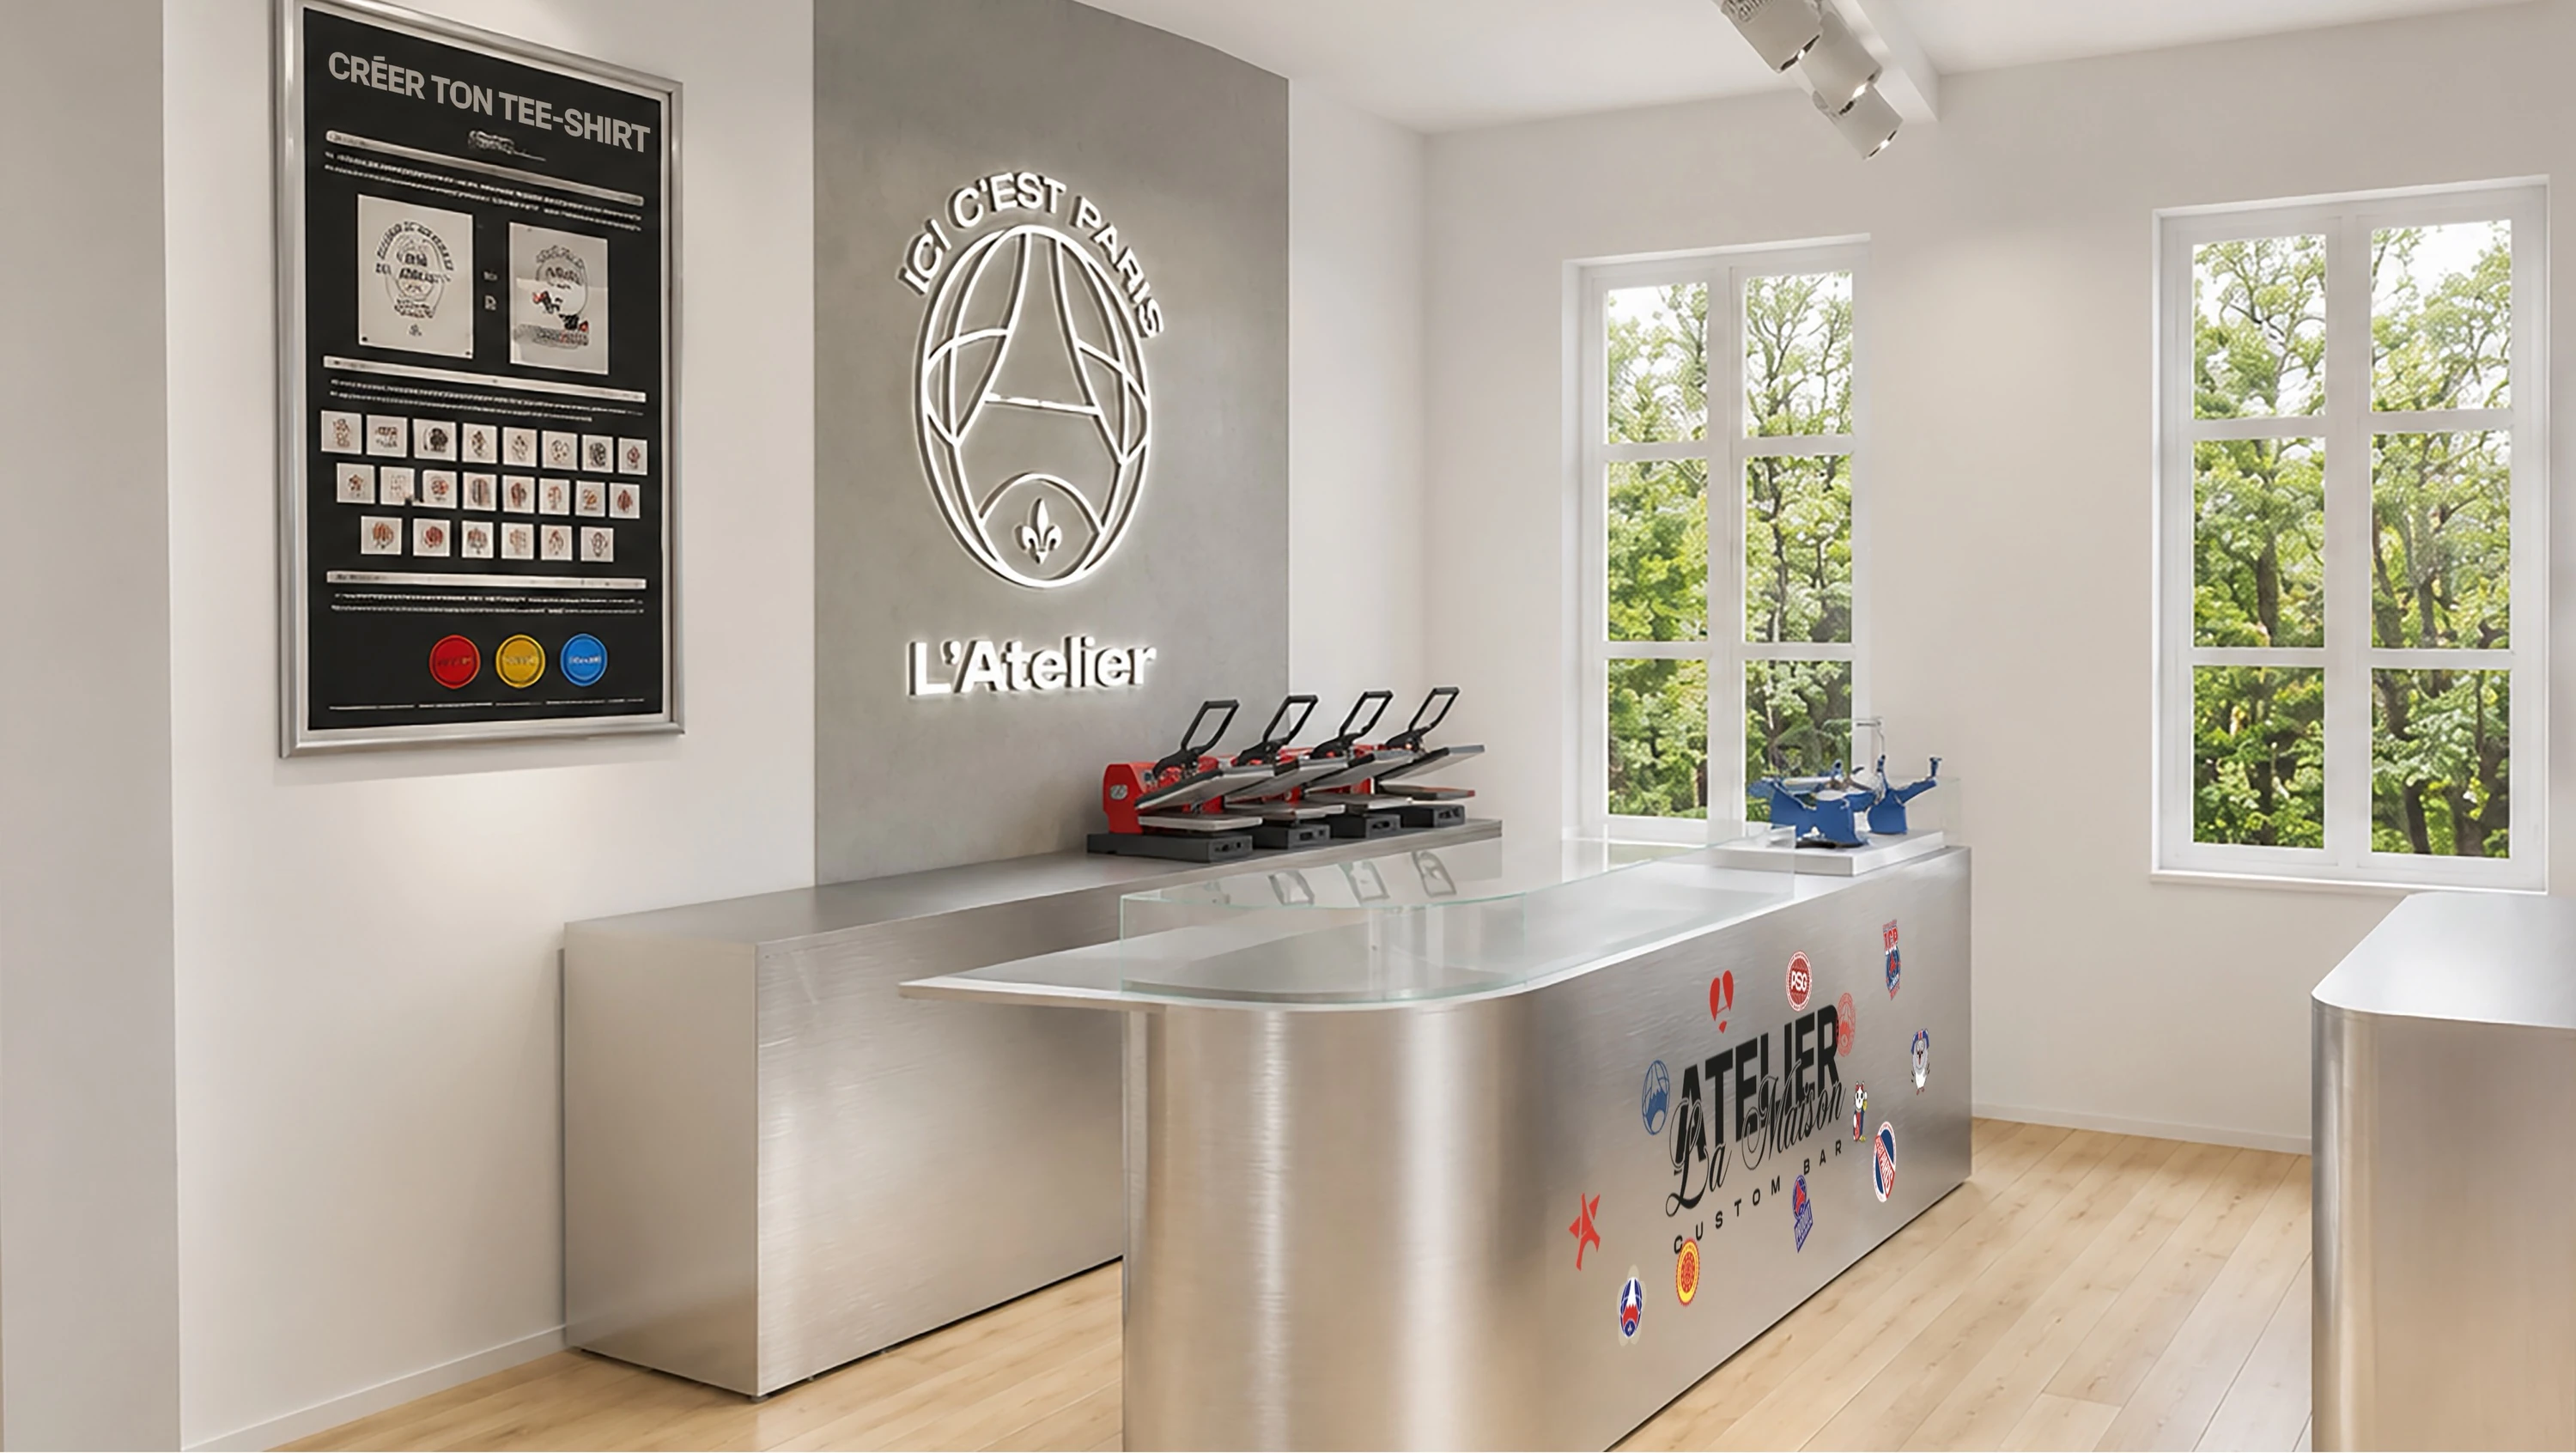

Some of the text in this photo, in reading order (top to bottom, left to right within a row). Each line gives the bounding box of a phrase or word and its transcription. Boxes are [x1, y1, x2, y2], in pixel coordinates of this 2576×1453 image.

[328, 52, 425, 100] CRÉER
[431, 75, 492, 116] TON
[499, 91, 650, 153] TEE-SHIRT
[899, 172, 1163, 337] ICI C'EST PARIS
[908, 635, 1157, 696] L'Atelier
[1791, 970, 1807, 992] PSG
[1666, 1059, 1845, 1217] La Maison
[1674, 1005, 1838, 1176] ATELIER
[1674, 1176, 1780, 1254] CUSTOM
[1804, 1140, 1841, 1176] BAR
